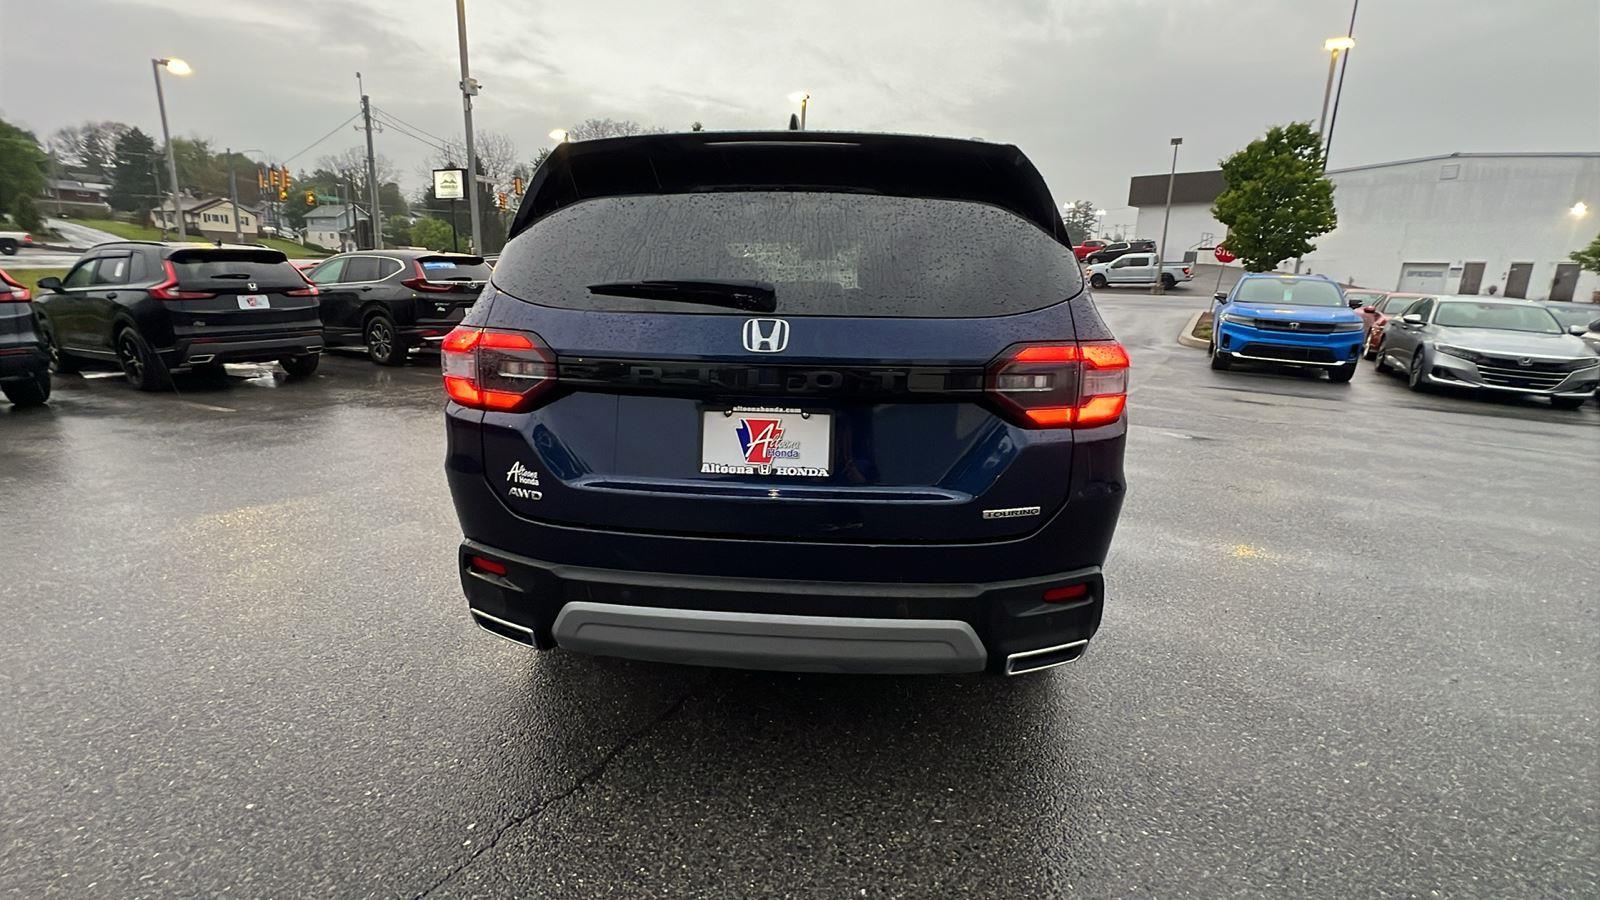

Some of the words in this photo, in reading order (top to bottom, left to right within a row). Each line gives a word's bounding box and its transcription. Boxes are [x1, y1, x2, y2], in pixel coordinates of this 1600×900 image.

[746, 423, 800, 458] Altoona
[767, 448, 800, 458] Honda
[701, 463, 754, 475] Altoona
[776, 466, 830, 477] HONDA
[519, 476, 539, 486] Honda
[508, 487, 542, 500] AWD
[986, 508, 1039, 517] TOURING
